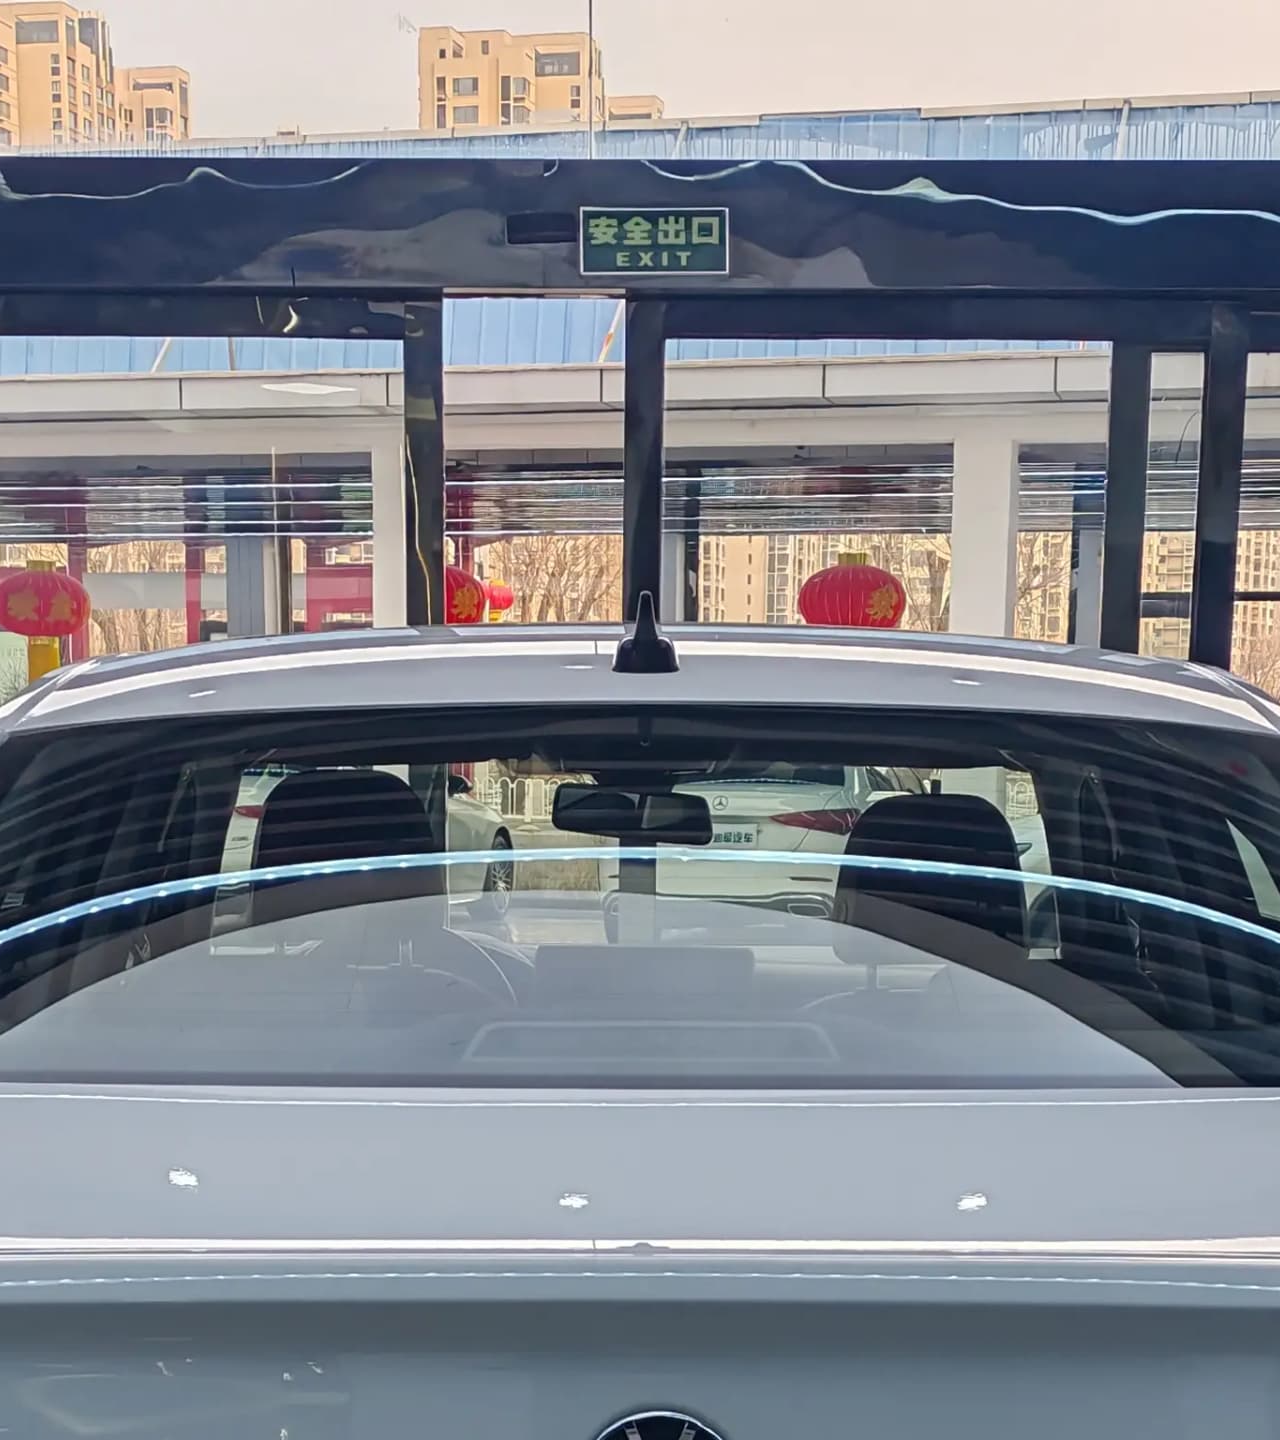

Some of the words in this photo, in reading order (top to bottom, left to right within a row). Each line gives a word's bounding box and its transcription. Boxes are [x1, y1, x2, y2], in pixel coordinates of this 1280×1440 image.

[588, 216, 719, 245] 安全出口
[616, 251, 692, 267] EXIT
